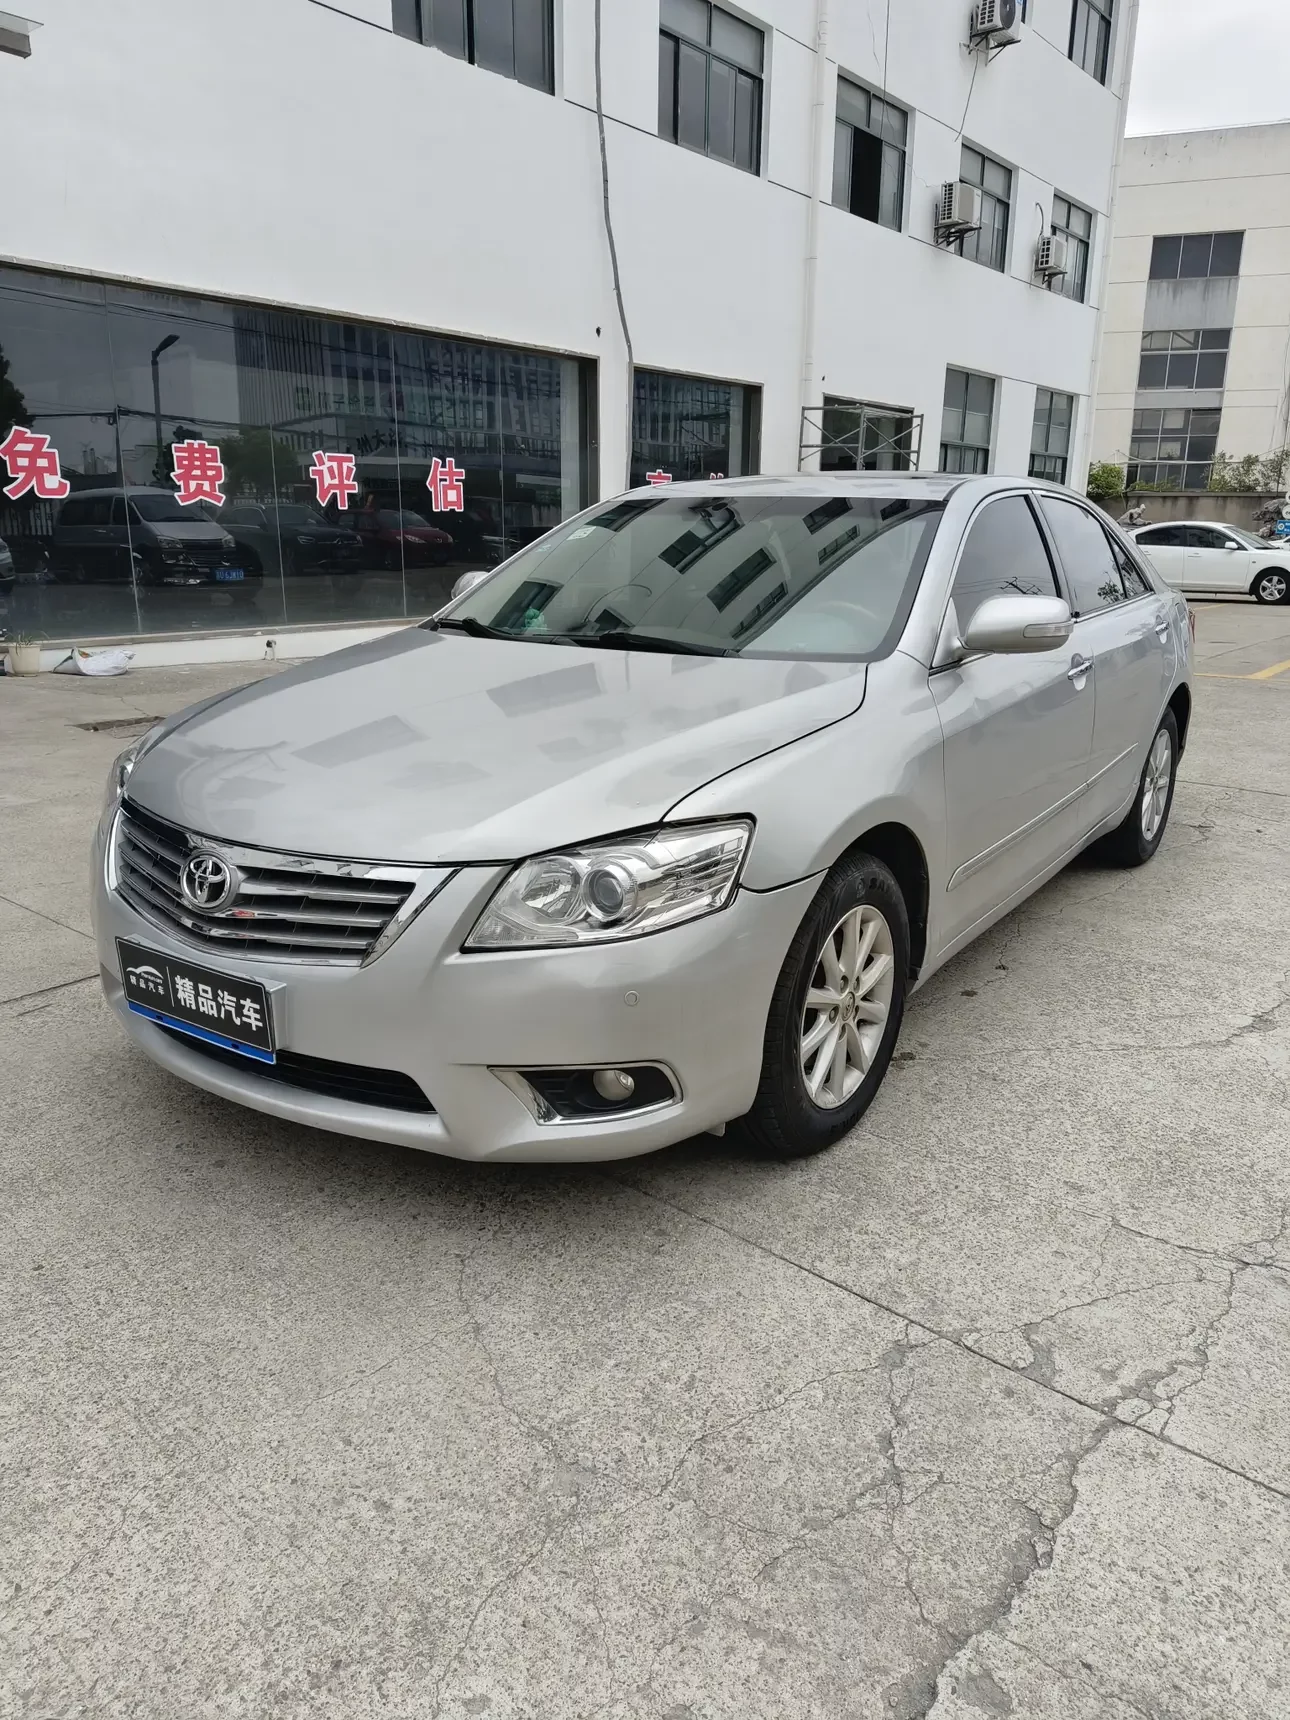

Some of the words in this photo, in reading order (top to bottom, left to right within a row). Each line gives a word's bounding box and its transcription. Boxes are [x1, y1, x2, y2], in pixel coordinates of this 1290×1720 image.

[0, 425, 465, 512] 免费评估
[175, 975, 264, 1032] 精品汽车
